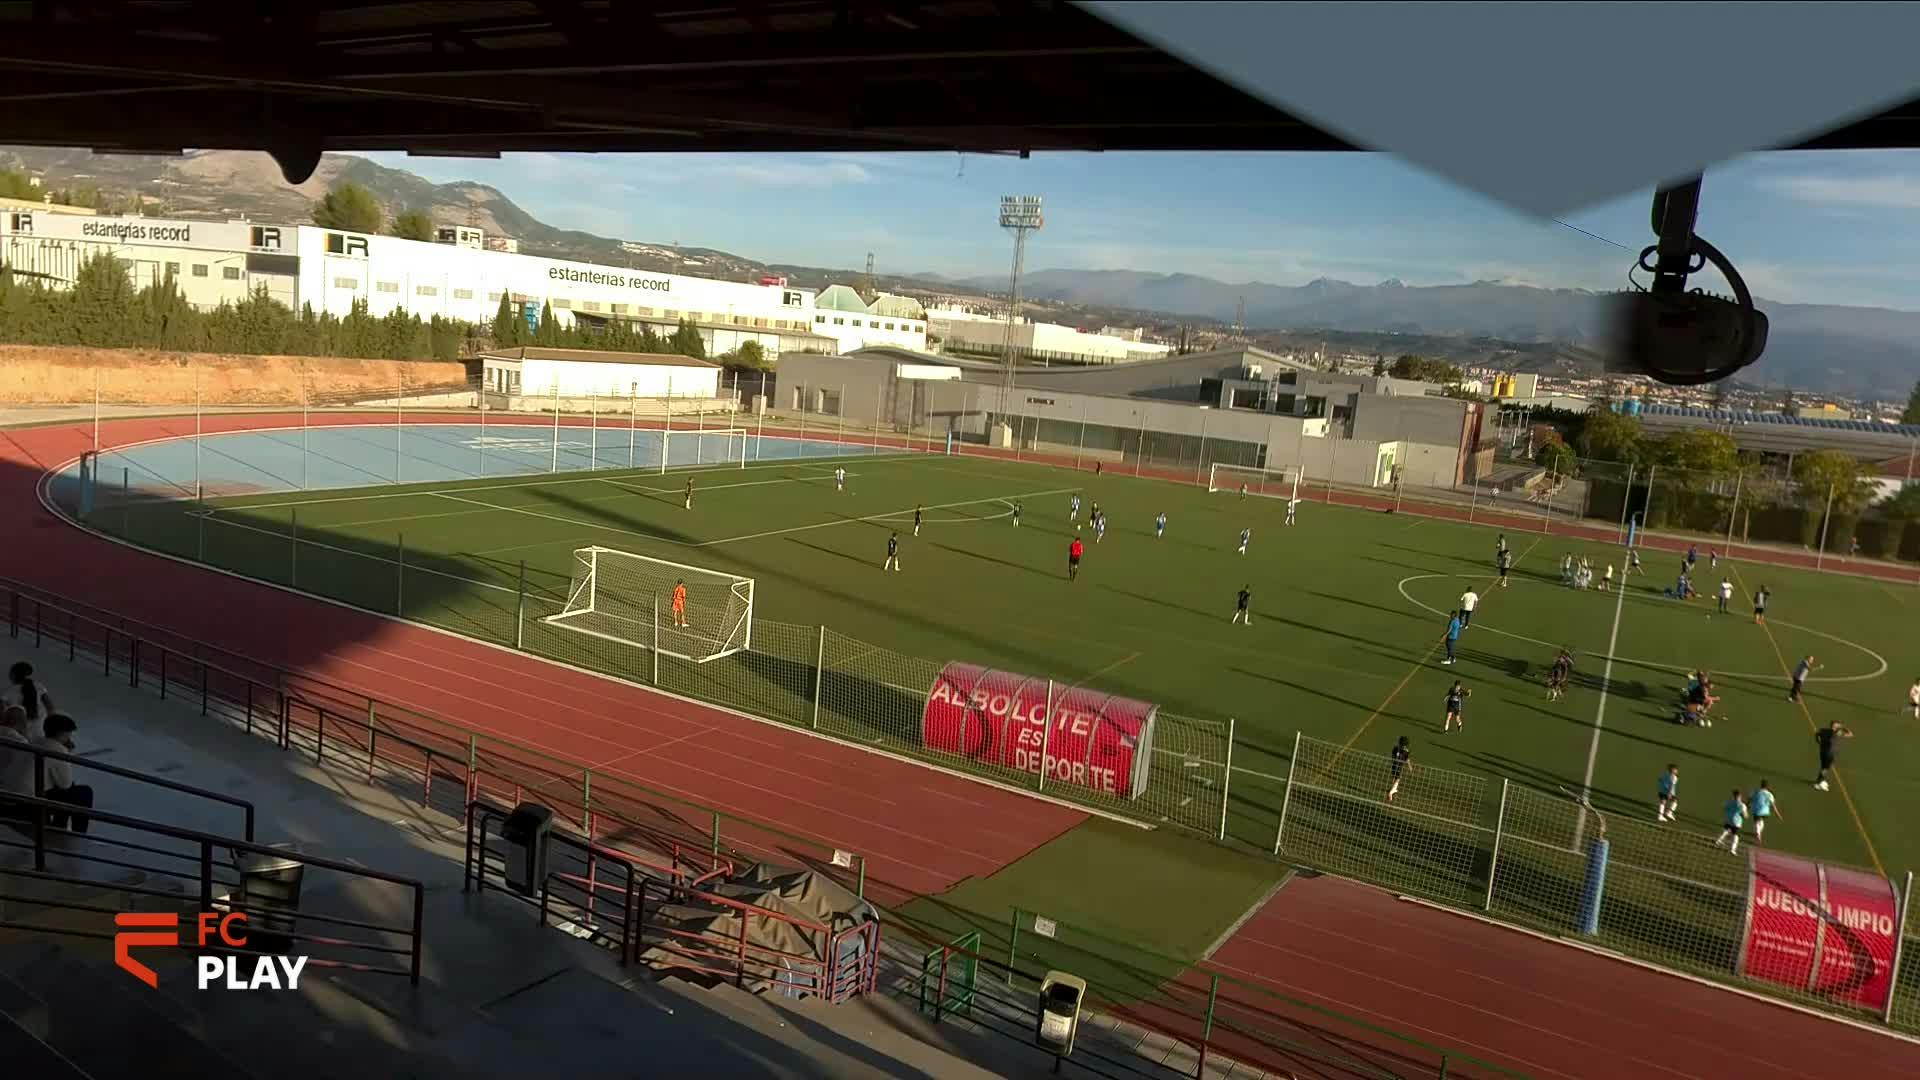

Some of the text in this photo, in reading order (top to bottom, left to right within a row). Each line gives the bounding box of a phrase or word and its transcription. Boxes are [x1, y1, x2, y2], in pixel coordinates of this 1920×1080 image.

[149, 224, 190, 242] record
[629, 276, 671, 292] record
[931, 682, 1090, 736] ALBOLOTE
[1017, 729, 1043, 746] ES
[1015, 748, 1115, 792] DEPORTE
